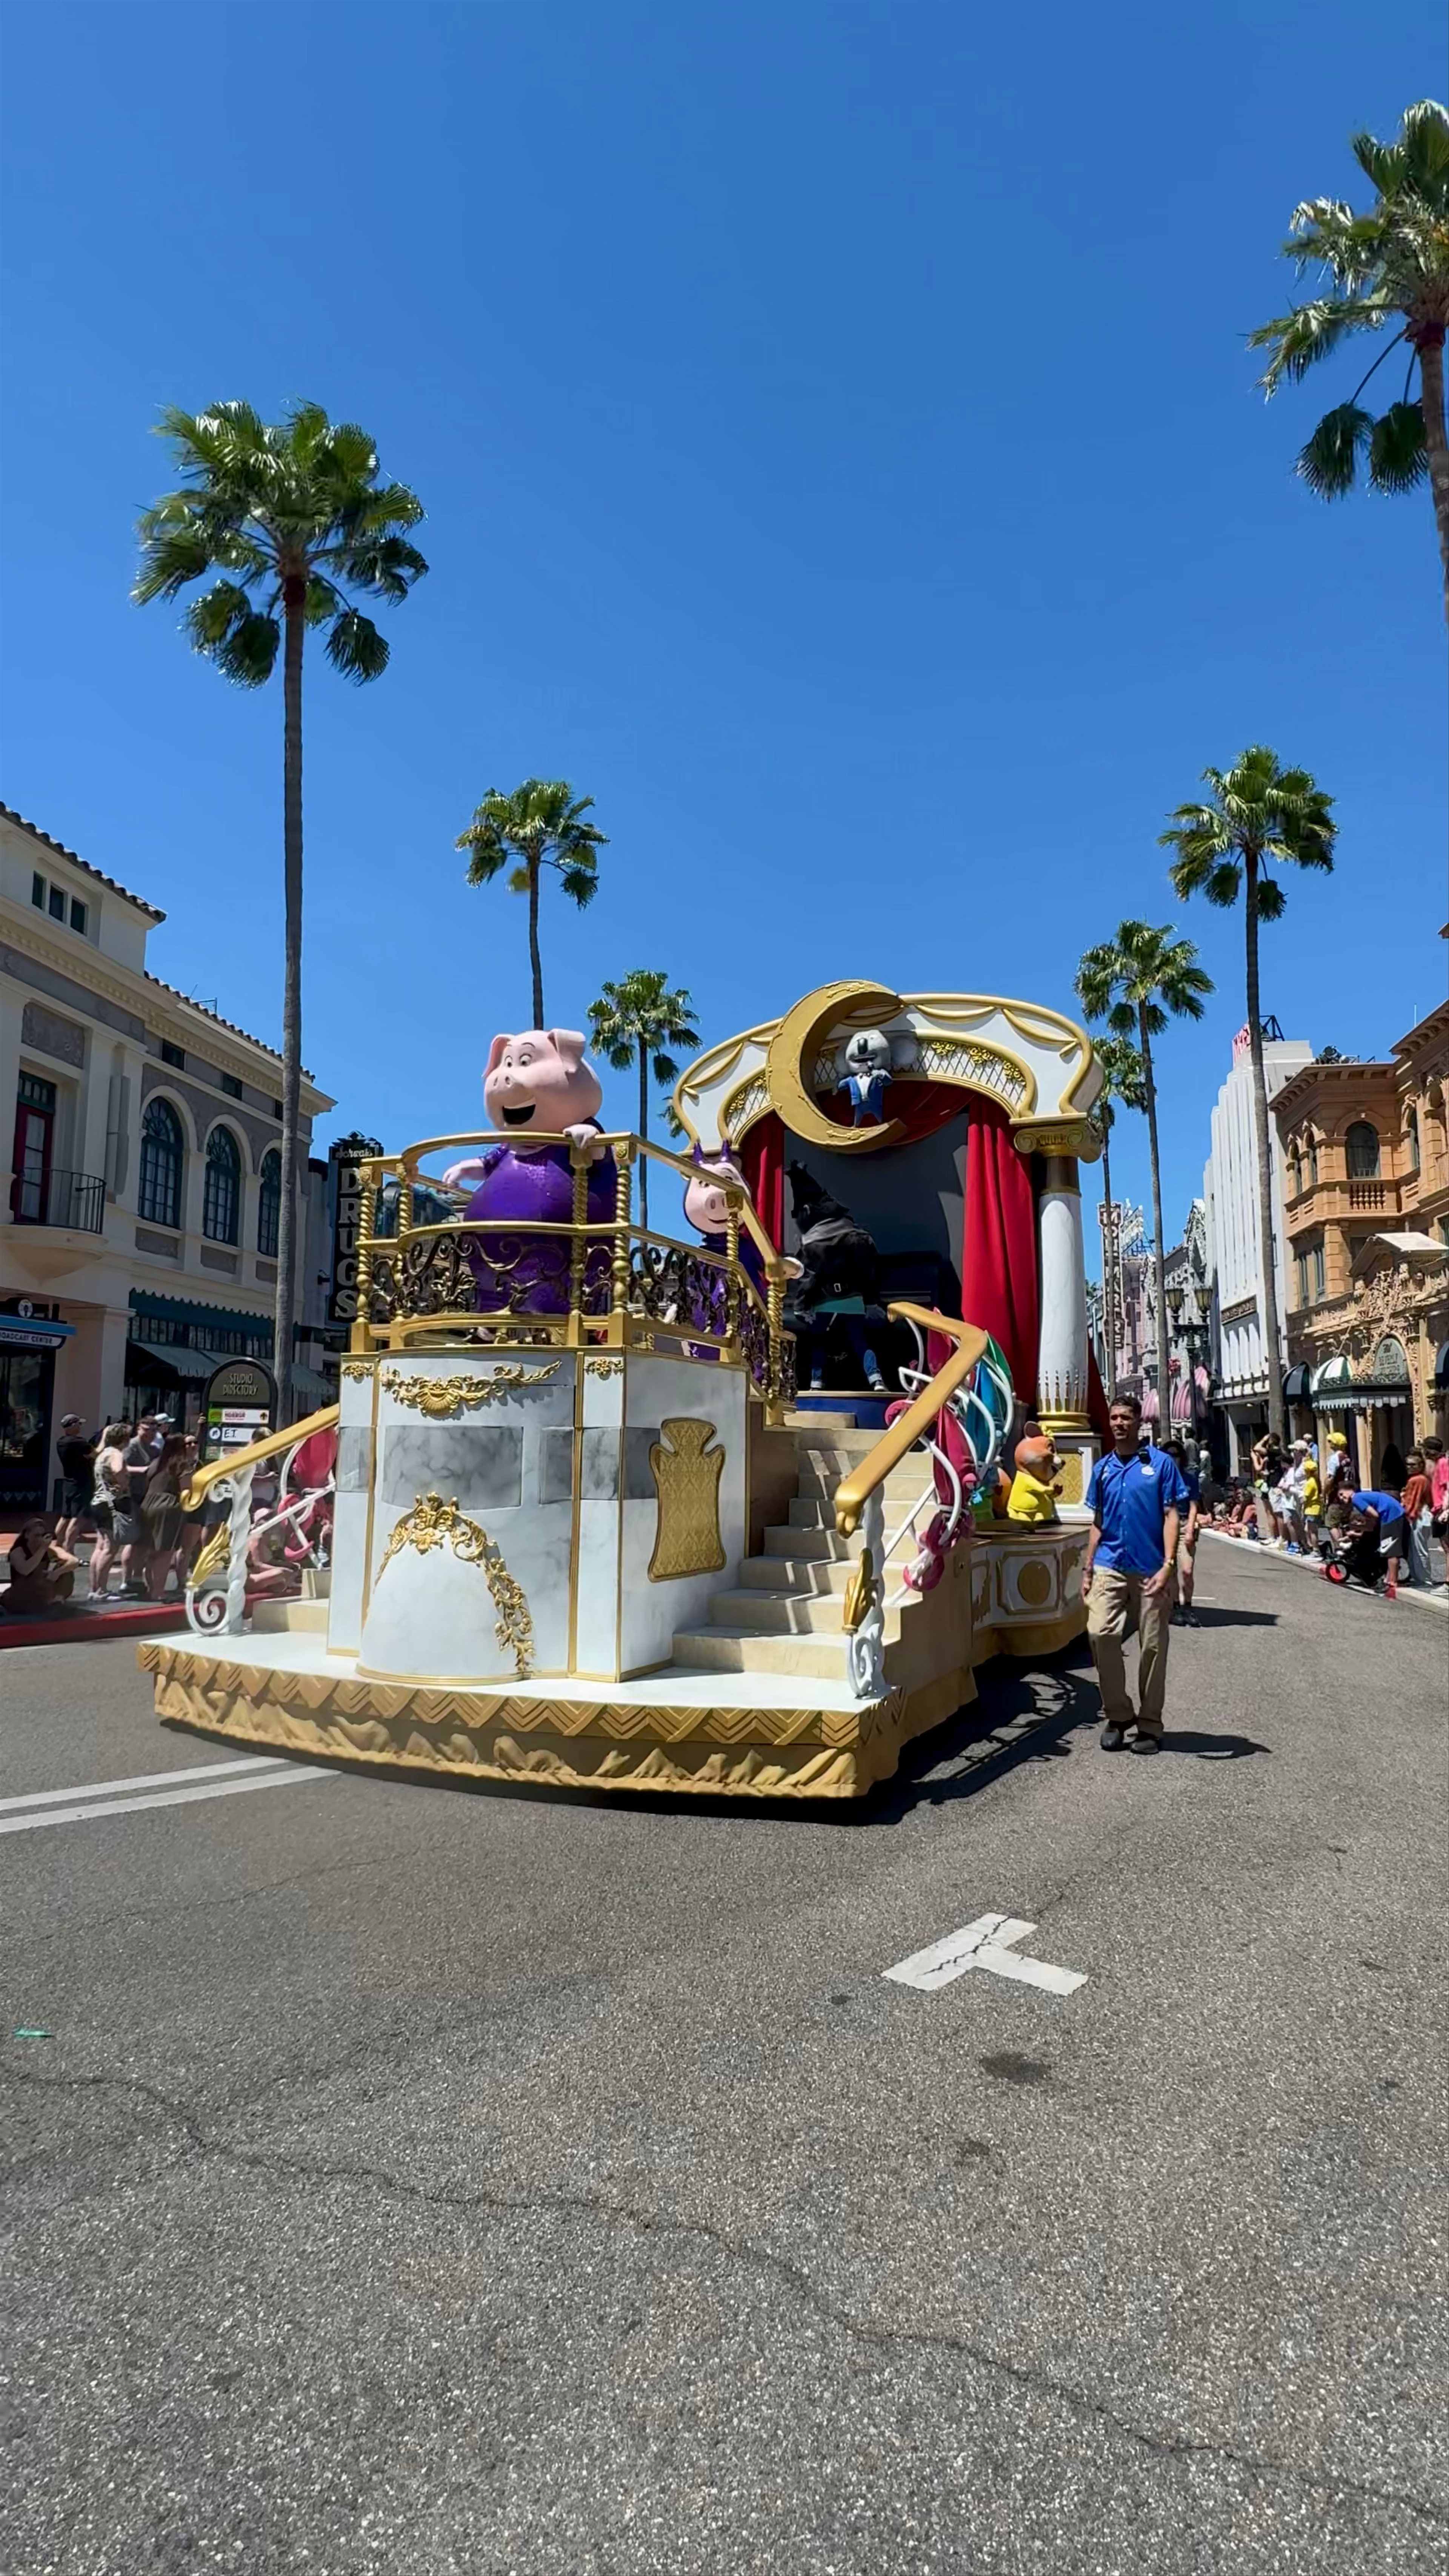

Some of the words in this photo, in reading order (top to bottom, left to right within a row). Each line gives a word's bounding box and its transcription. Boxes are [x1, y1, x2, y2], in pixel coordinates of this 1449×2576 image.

[335, 1167, 361, 1318] DRUGS
[0, 1331, 29, 1341] OADCAST
[229, 1373, 253, 1384] STUDIO
[223, 1384, 258, 1396] DIRECTORY
